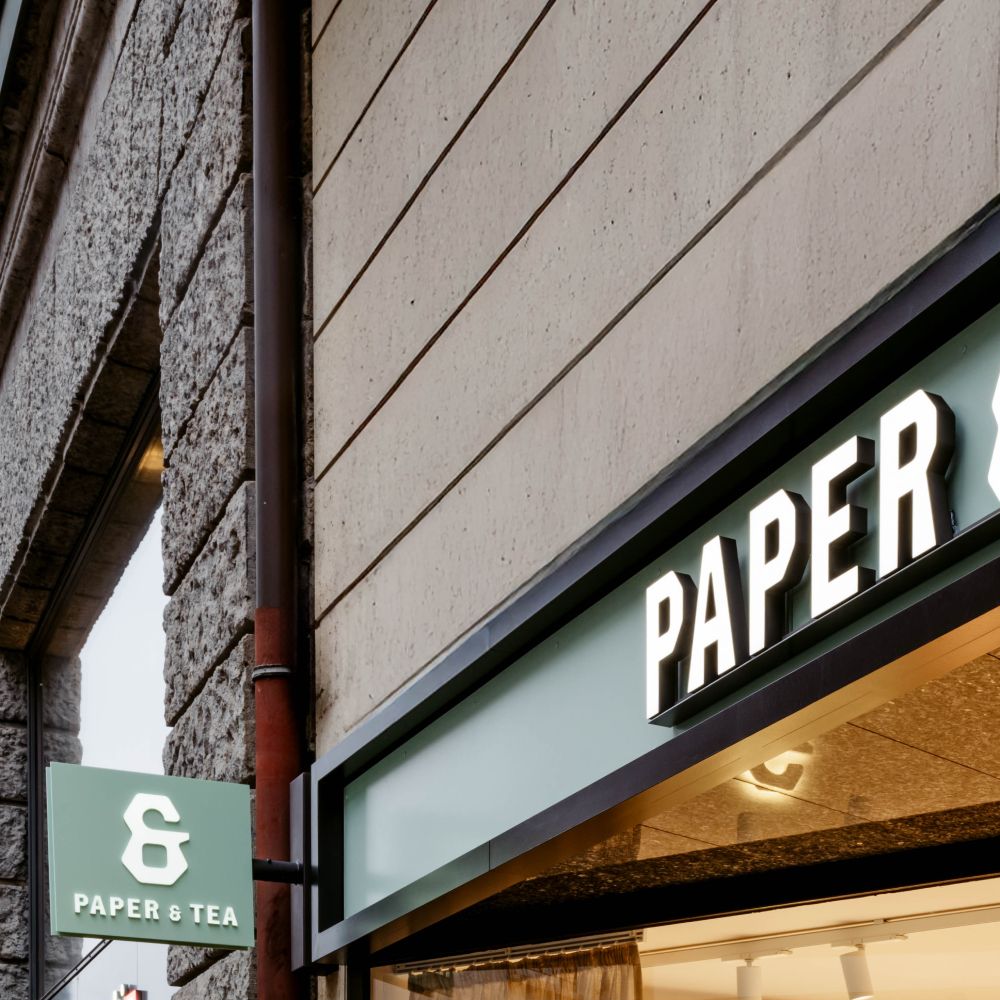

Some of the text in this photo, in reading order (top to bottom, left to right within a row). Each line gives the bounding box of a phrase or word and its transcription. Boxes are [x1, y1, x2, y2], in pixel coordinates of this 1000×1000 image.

[645, 389, 944, 718] PAPER
[121, 793, 190, 886] &
[73, 892, 239, 928] PAPER & TEA
